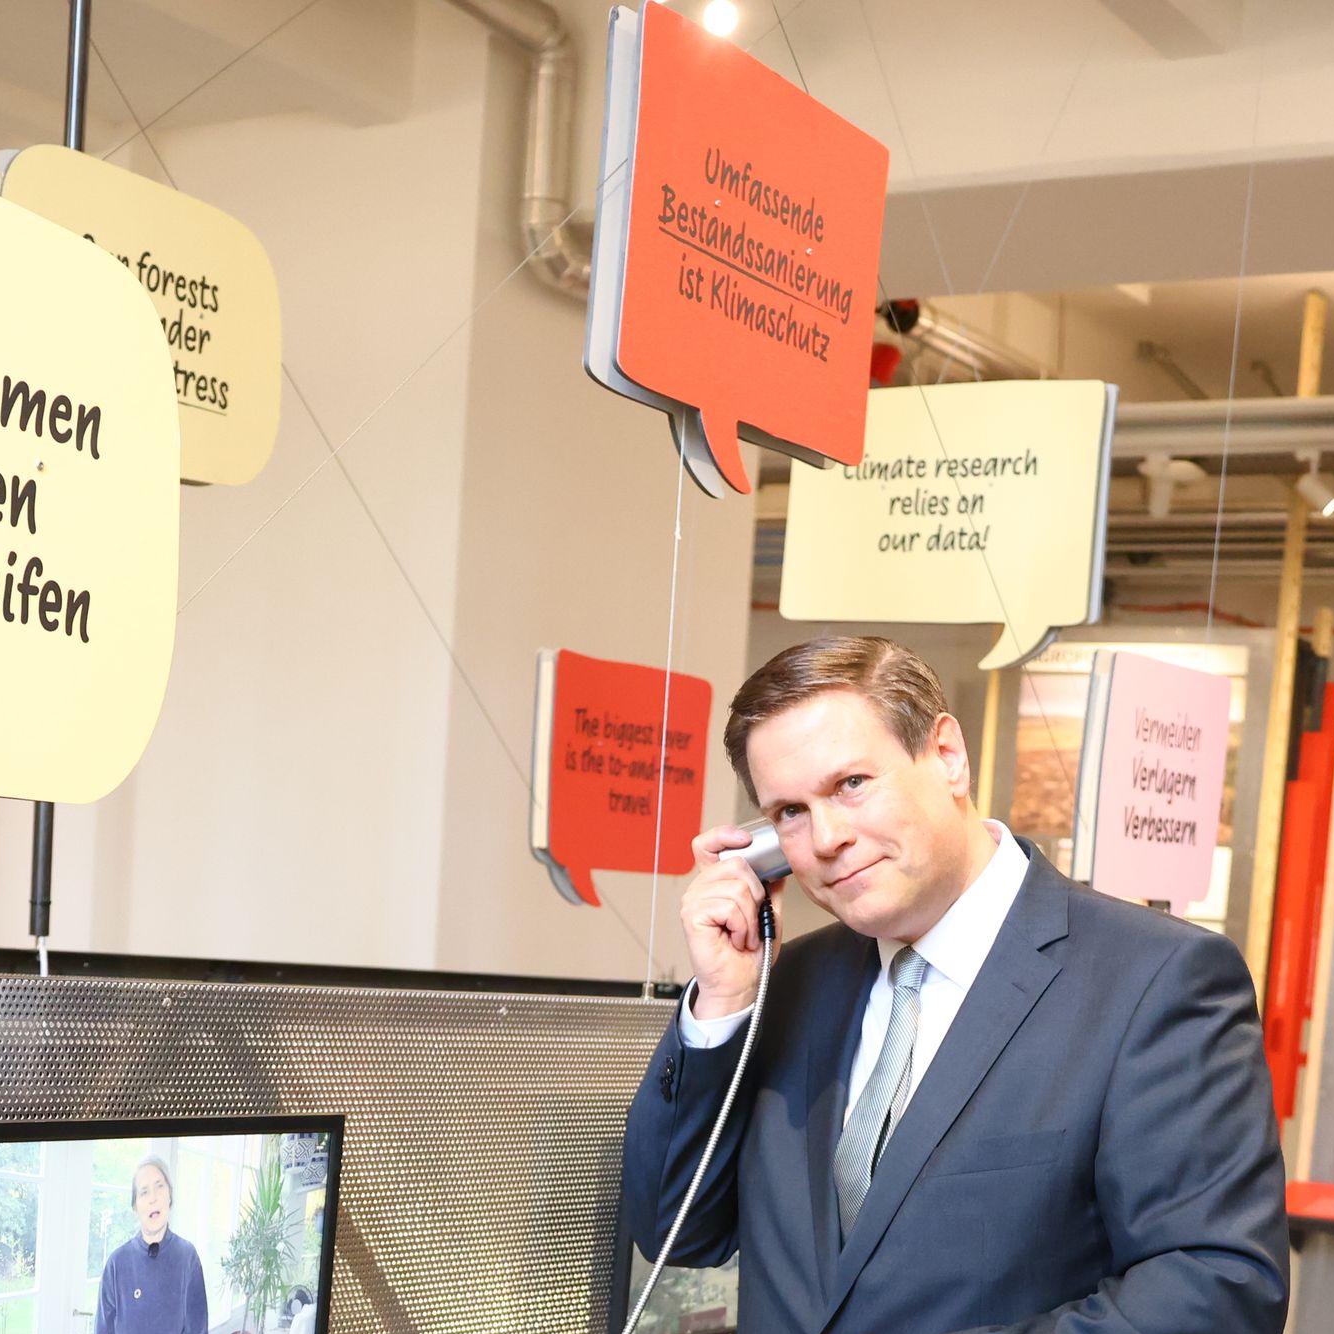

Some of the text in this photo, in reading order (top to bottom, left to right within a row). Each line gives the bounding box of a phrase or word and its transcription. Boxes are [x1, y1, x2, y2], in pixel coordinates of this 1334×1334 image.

[705, 148, 824, 242] Umfassende
[658, 184, 853, 324] Bestandssanierung
[137, 251, 218, 312] forests
[679, 253, 829, 362] ist Klimaschutz
[173, 360, 228, 410] tress
[935, 448, 1037, 478] research
[889, 488, 984, 516] relies on
[878, 523, 990, 552] our data!
[575, 708, 599, 738] The
[604, 712, 654, 751] biggest
[1135, 707, 1202, 750] Vermeiden
[566, 743, 576, 772] is
[581, 746, 604, 775] the
[1132, 756, 1197, 805] Verlagern
[608, 789, 652, 816] travel
[1124, 805, 1197, 846] Verbessern
